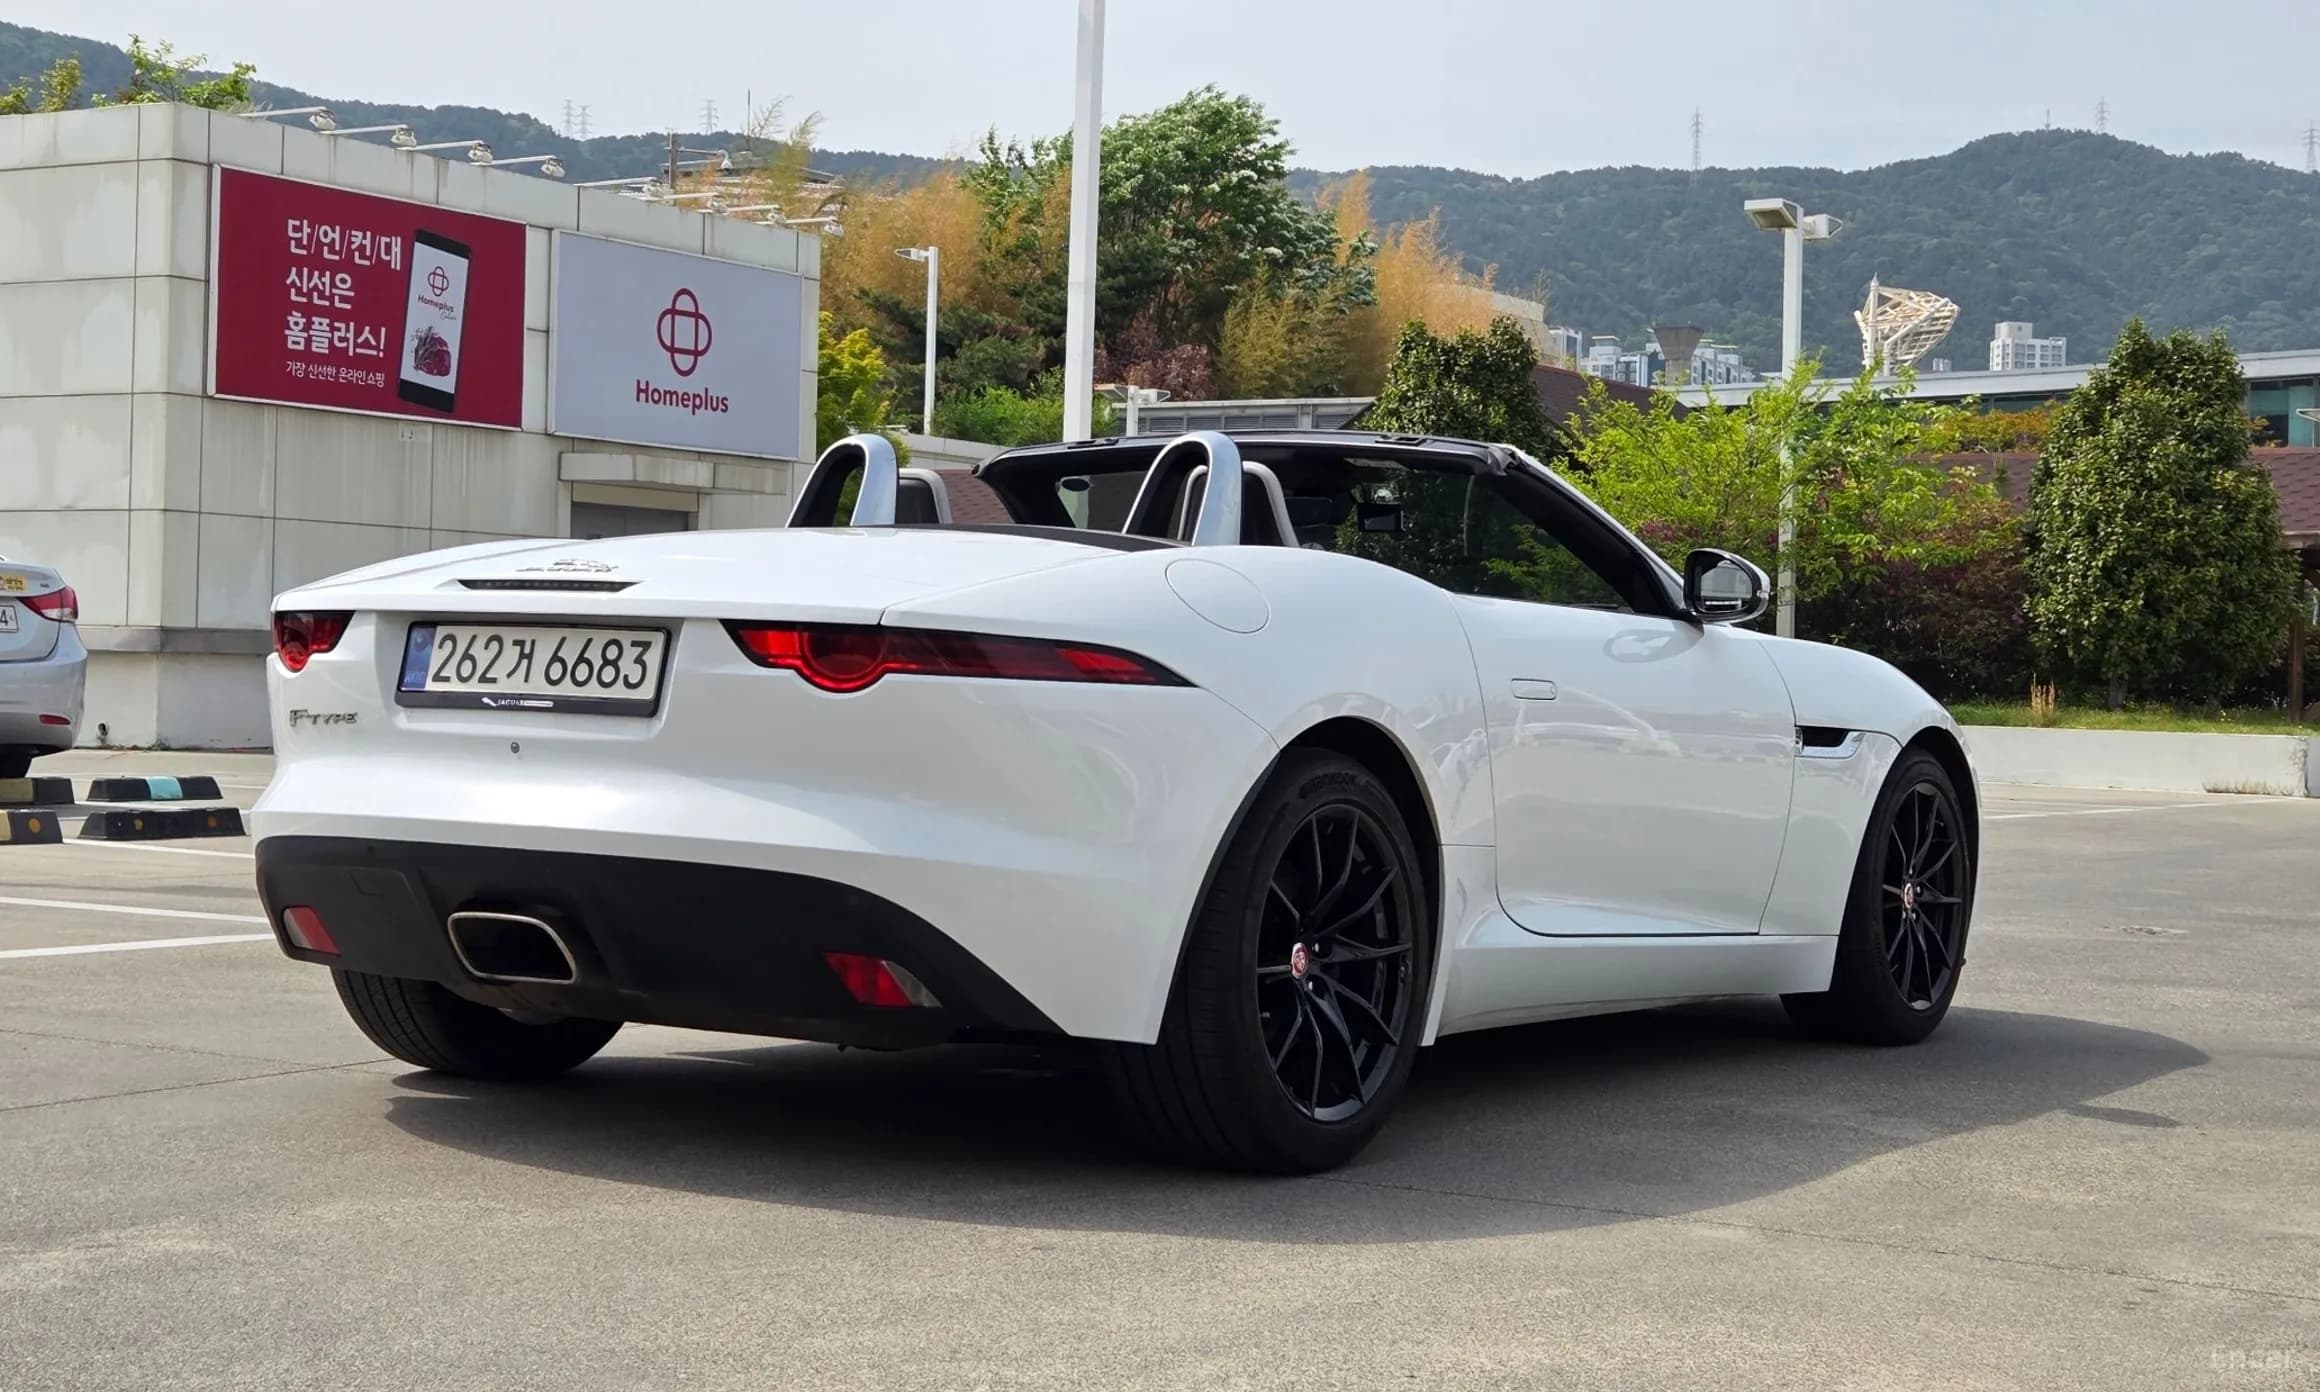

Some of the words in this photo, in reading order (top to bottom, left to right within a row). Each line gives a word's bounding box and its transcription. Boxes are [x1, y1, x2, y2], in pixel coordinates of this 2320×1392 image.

[287, 218, 402, 271] 단/언/컨/대
[285, 266, 355, 310] 신선은
[284, 310, 386, 358] 홈플러스!
[286, 361, 306, 378] 가장
[307, 364, 337, 382] 신선한
[636, 379, 729, 416] Homeplus
